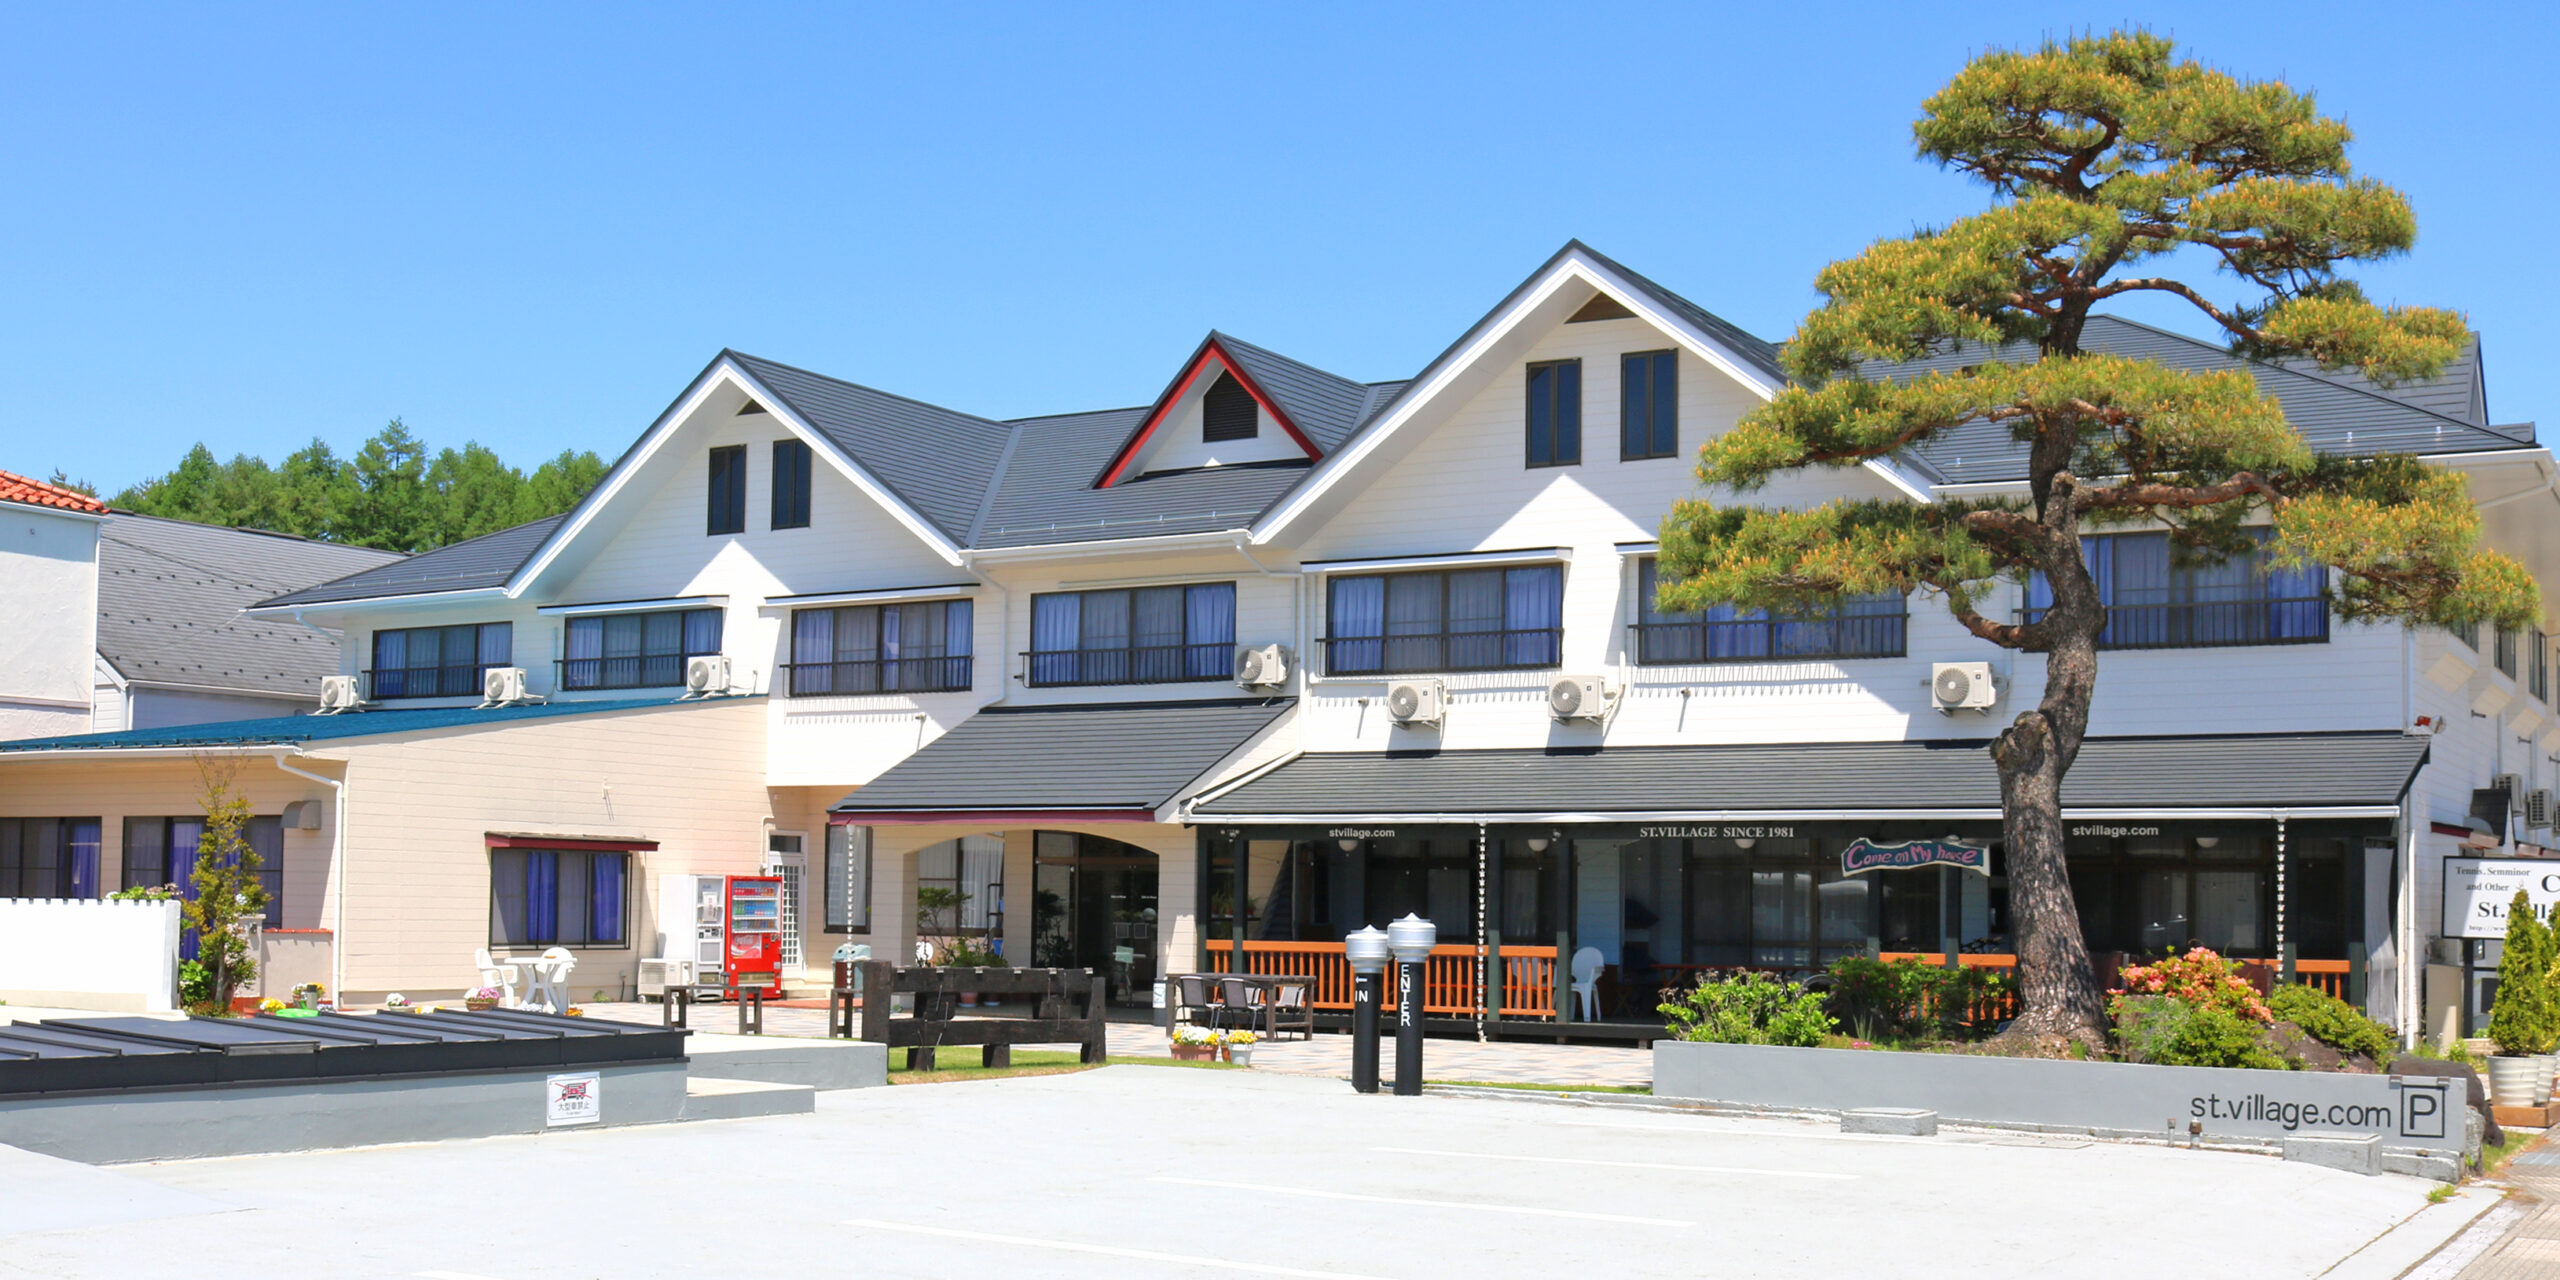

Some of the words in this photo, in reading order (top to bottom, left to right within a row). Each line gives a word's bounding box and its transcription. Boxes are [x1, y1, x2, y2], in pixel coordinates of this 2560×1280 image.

[1329, 827, 1395, 839] stvillage.com
[1639, 826, 1718, 838] ST.VILLAGE
[1722, 826, 1765, 838] SINCE
[1768, 826, 1795, 838] 1981
[2072, 824, 2159, 838] stvillage.com
[1847, 844, 1892, 868] Come
[1910, 844, 1932, 863] My
[2466, 882, 2482, 891] and
[2484, 882, 2510, 891] Other
[1355, 990, 1368, 1003] IN
[1400, 964, 1411, 1026] ENTER
[2190, 1093, 2391, 1131] st.village.com
[2410, 1094, 2437, 1130] P
